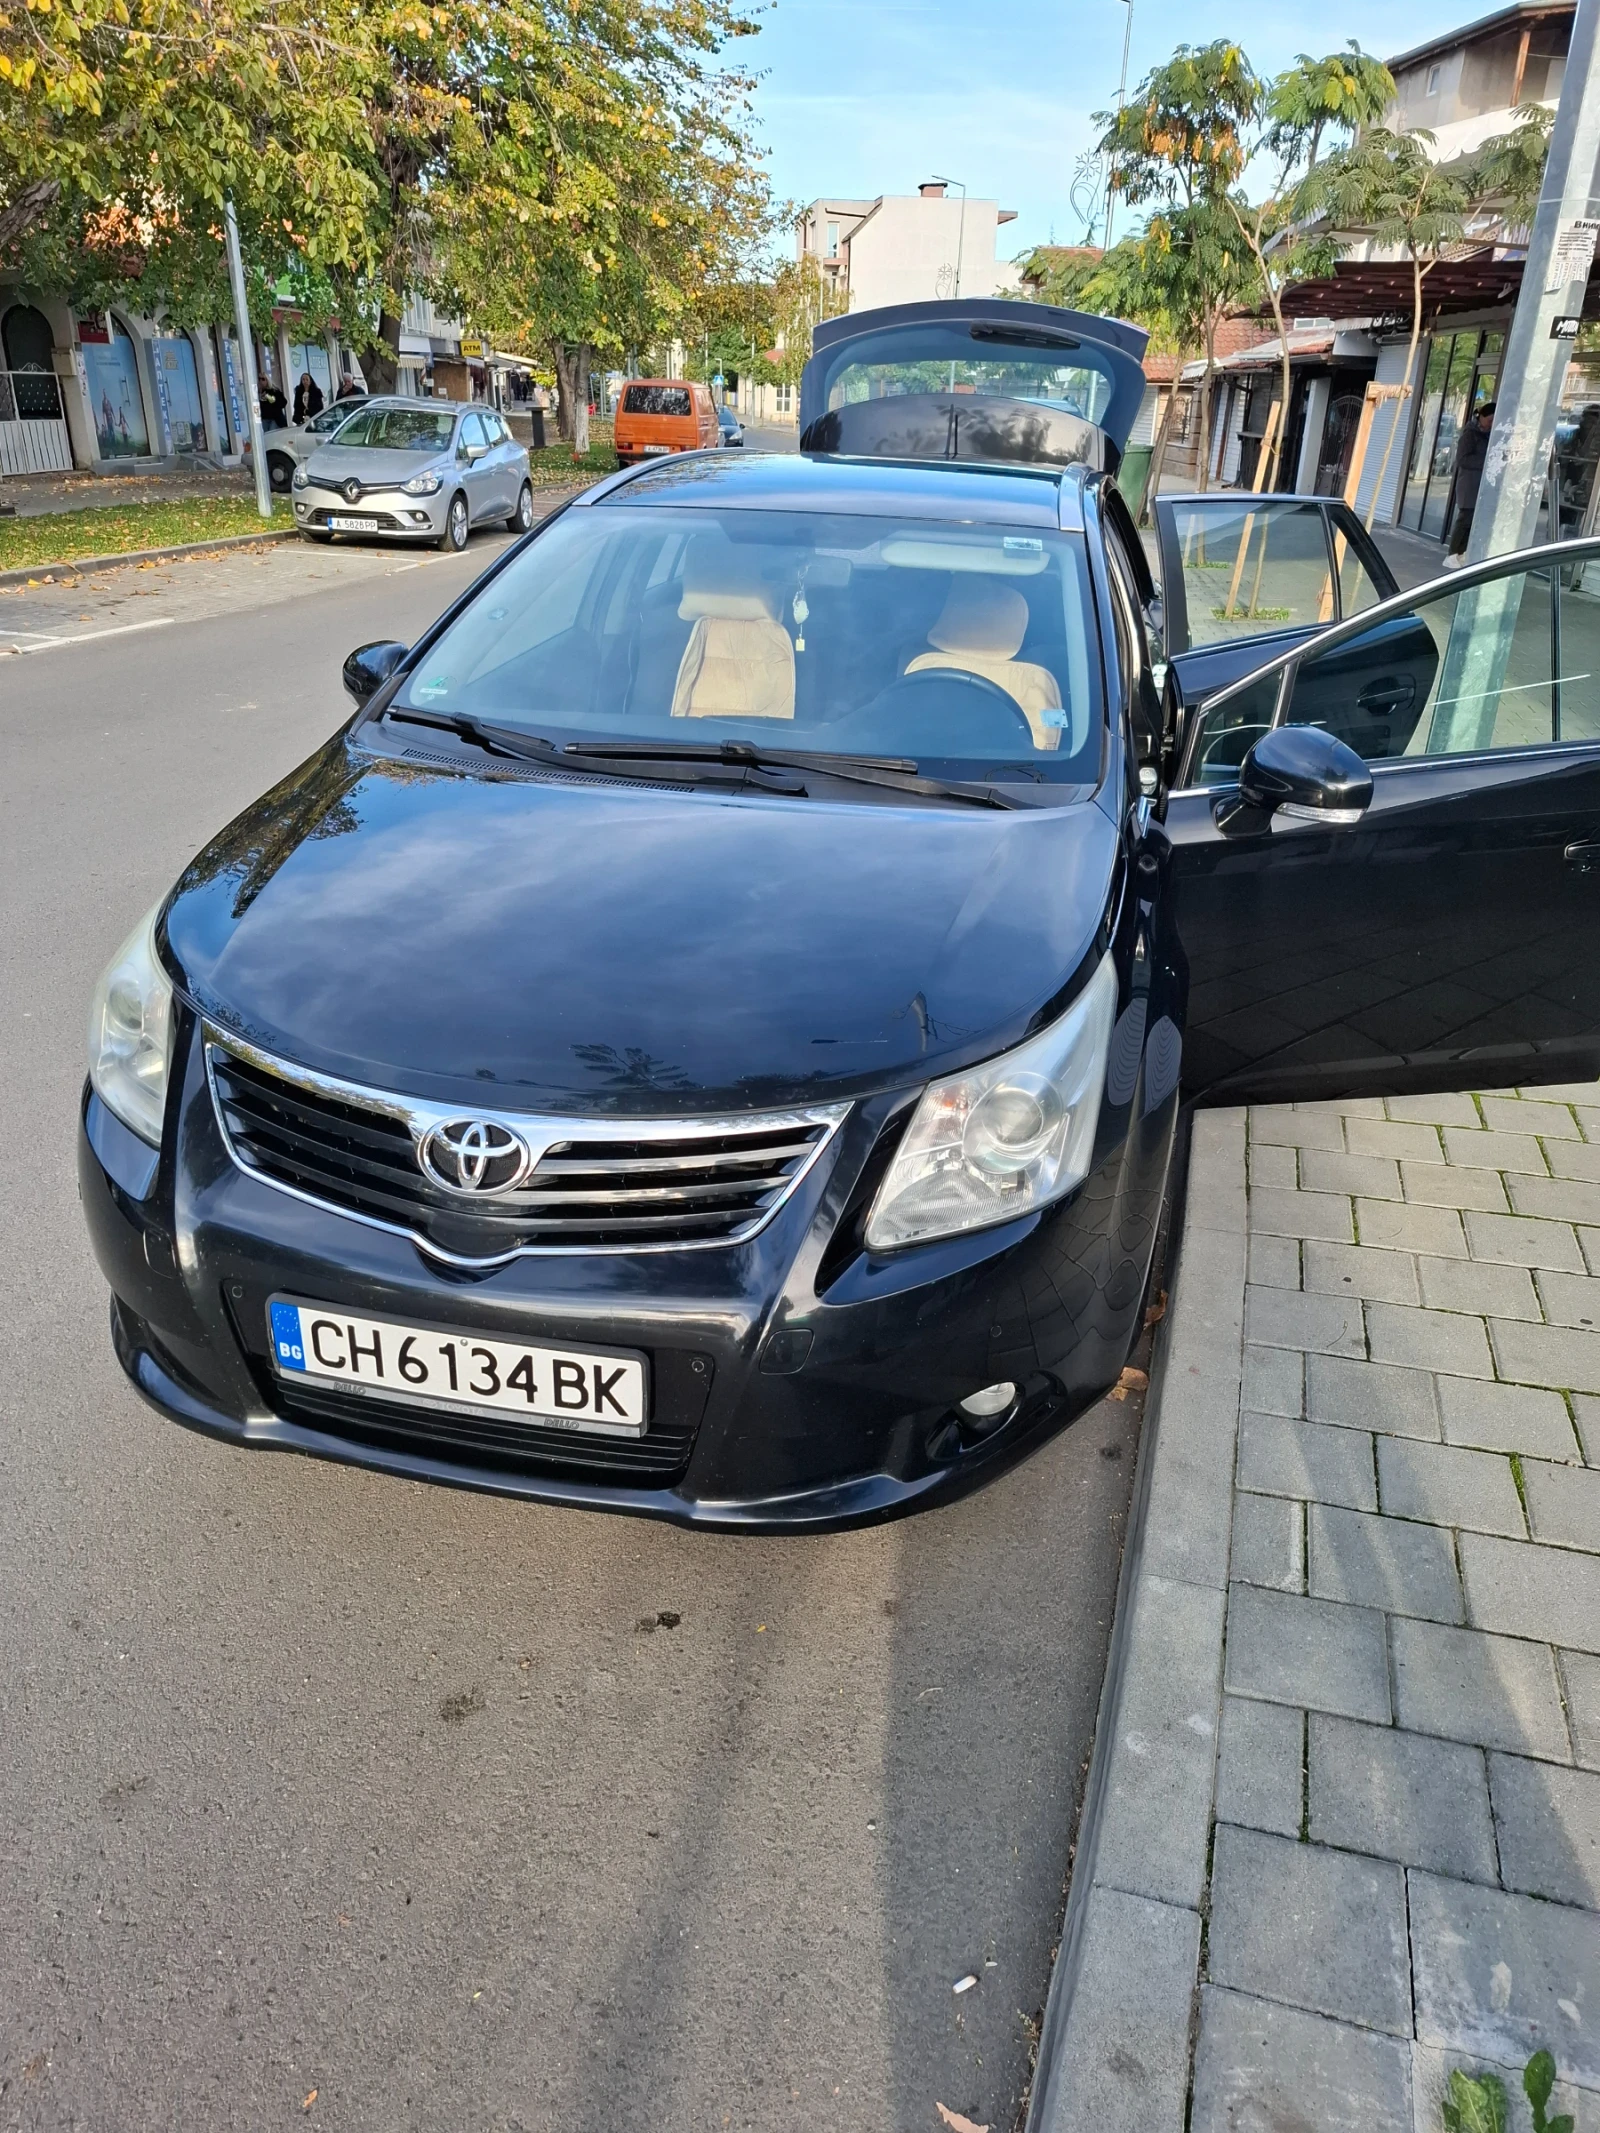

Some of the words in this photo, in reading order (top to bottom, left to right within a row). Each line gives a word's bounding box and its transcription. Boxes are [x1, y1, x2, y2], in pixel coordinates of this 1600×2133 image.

[223, 340, 241, 432] PHARMACY
[279, 1341, 303, 1361] BG
[332, 1381, 367, 1396] DELLO
[543, 1417, 580, 1430] DELLO
